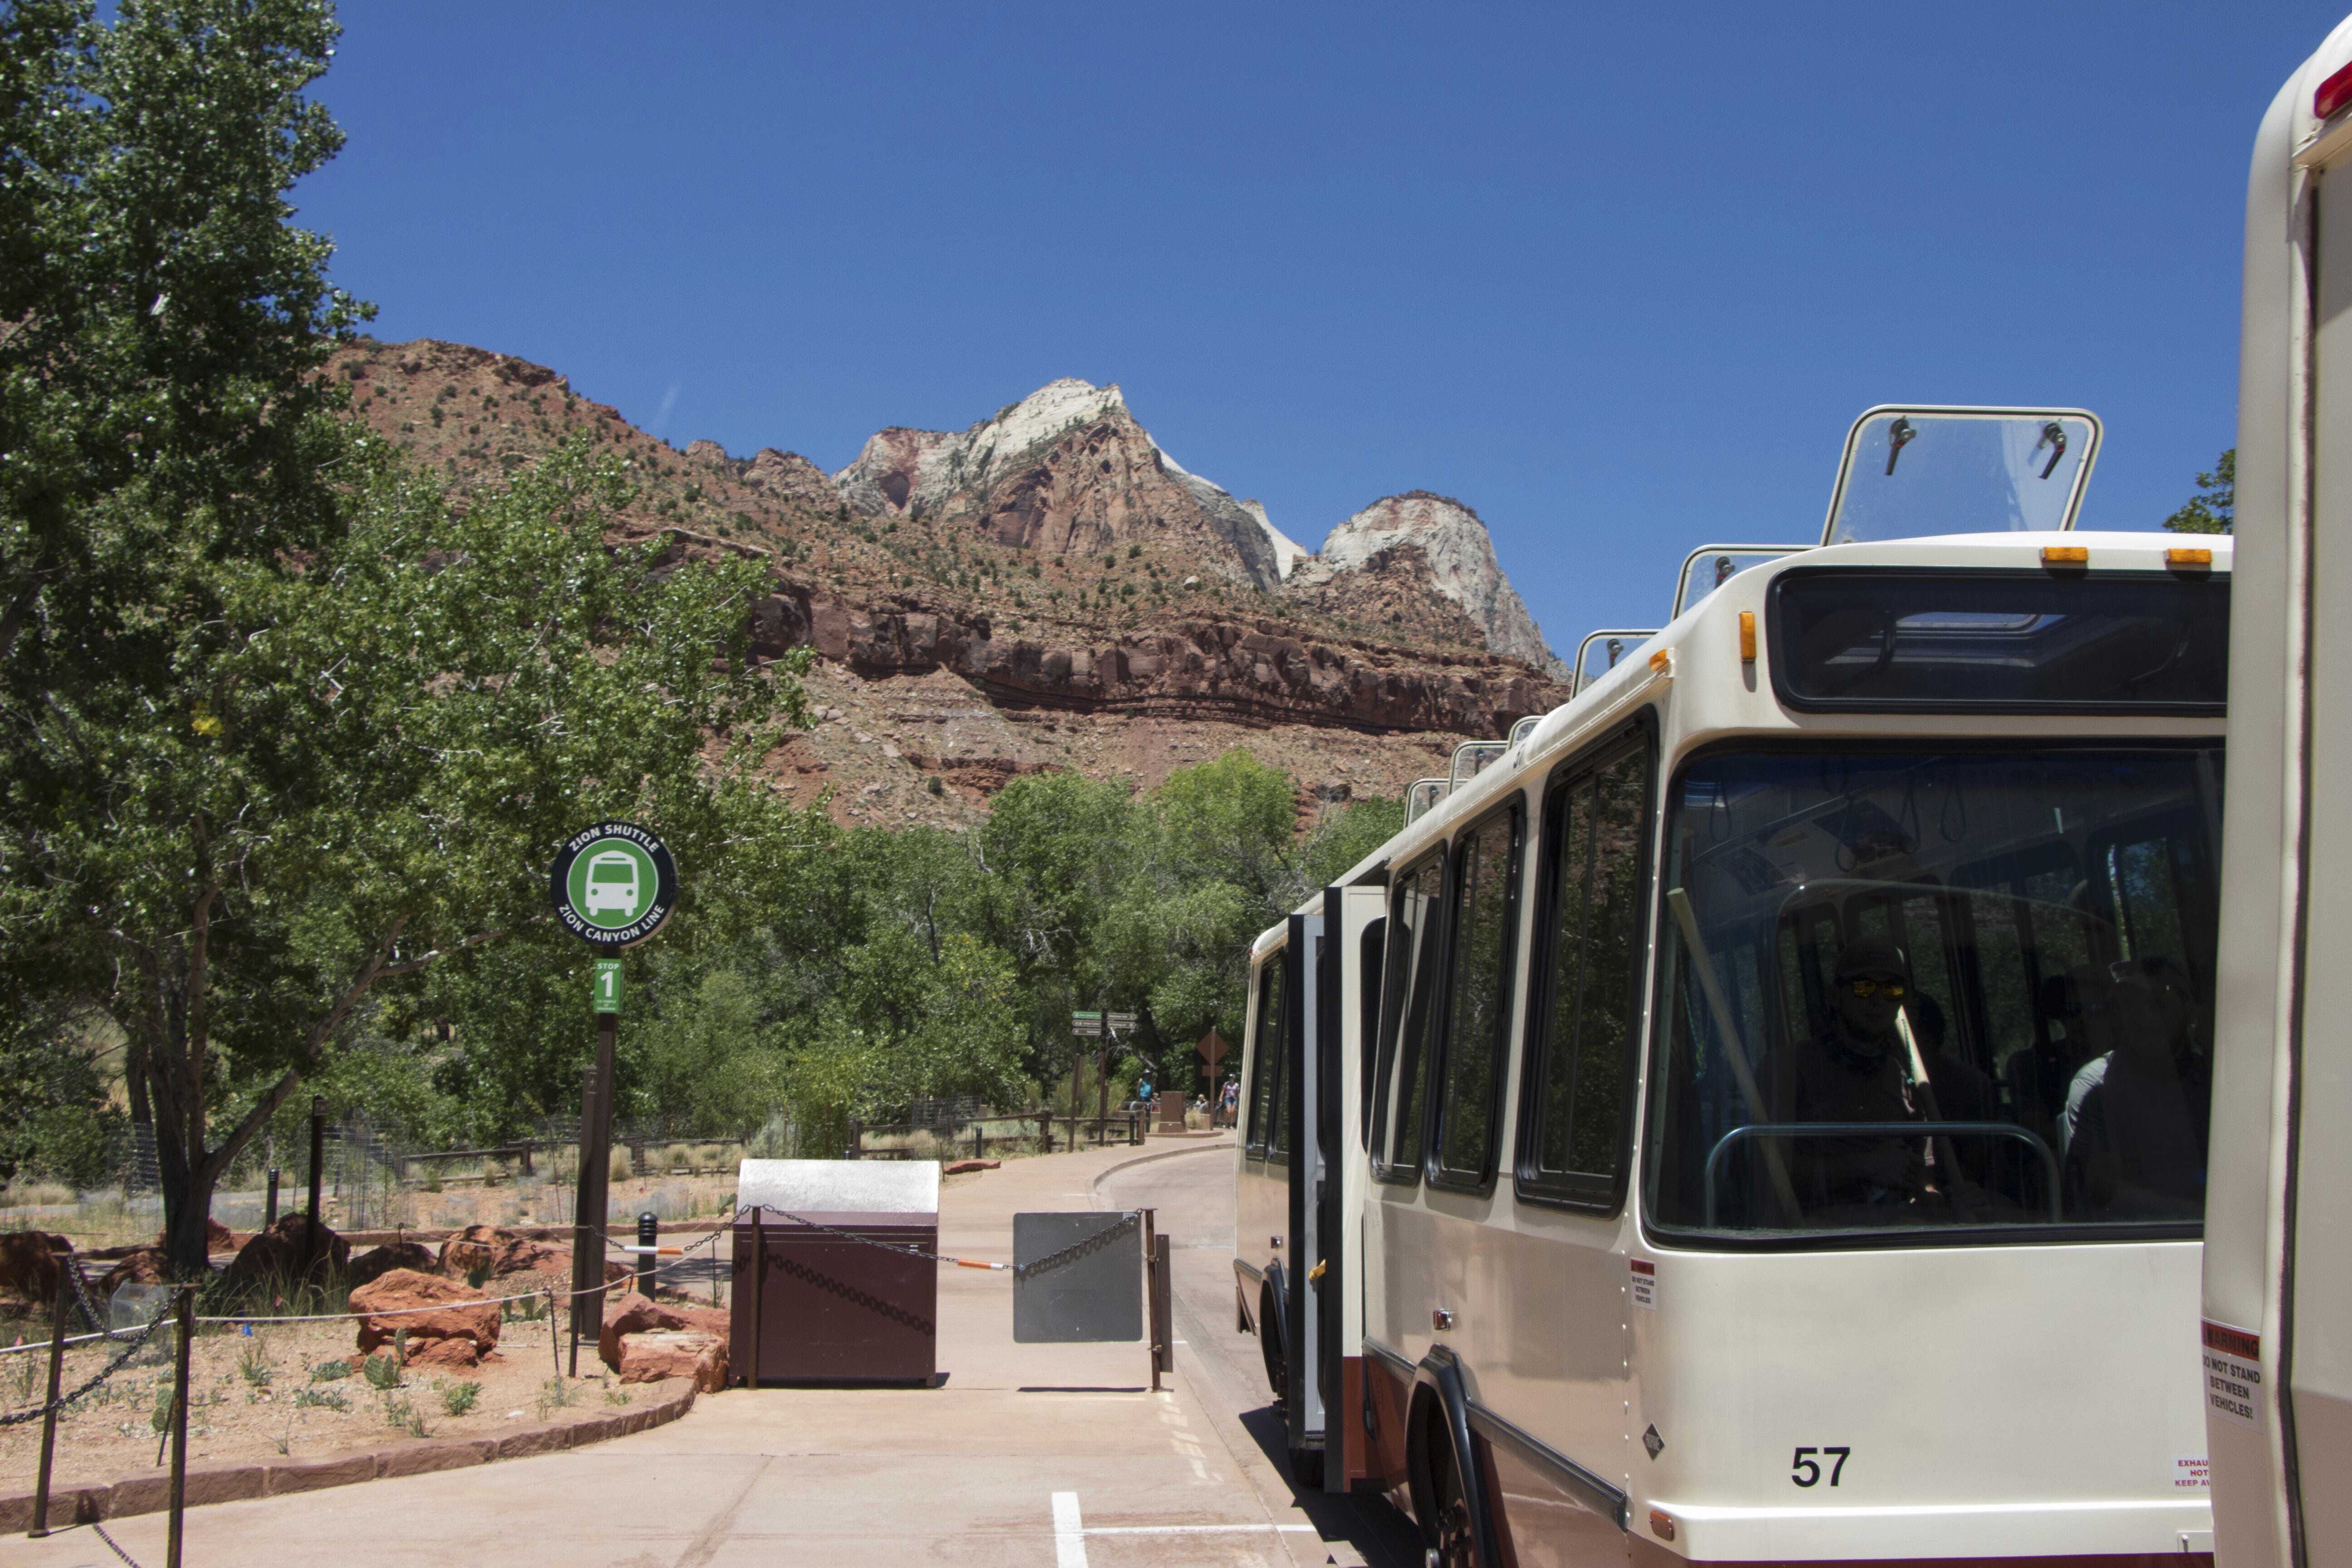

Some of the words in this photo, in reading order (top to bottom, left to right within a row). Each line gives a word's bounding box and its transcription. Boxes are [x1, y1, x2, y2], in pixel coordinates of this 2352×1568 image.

[568, 827, 601, 852] ZION
[605, 824, 660, 853] SHUTTLE
[559, 904, 584, 931] ZION
[585, 926, 640, 942] CANYON
[641, 905, 664, 930] LINE
[600, 971, 613, 997] 1
[2207, 1328, 2259, 1358] WARNING
[2211, 1357, 2228, 1374] NOT
[2230, 1364, 2260, 1383] STAND
[2210, 1375, 2249, 1400] BETWEEN
[2210, 1393, 2253, 1419] VEHICLES!
[1792, 1446, 1850, 1487] 57
